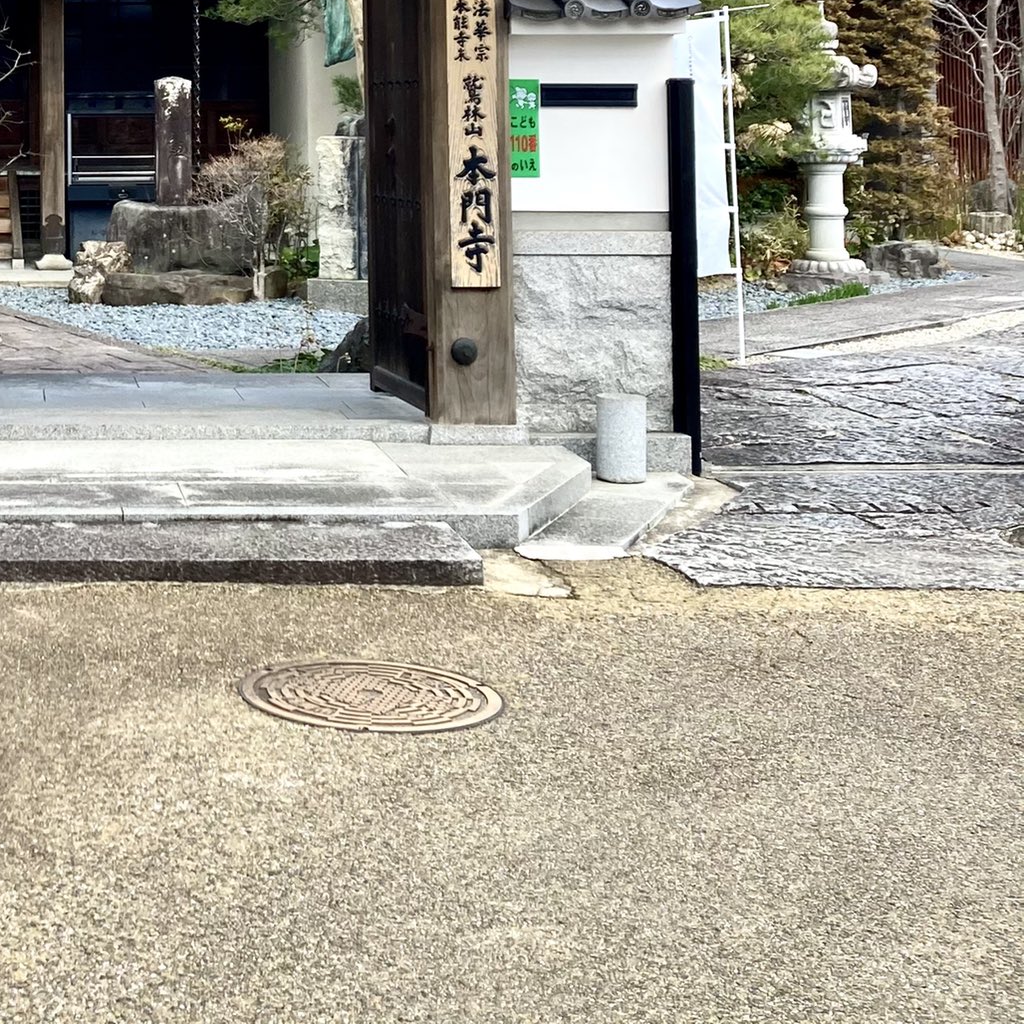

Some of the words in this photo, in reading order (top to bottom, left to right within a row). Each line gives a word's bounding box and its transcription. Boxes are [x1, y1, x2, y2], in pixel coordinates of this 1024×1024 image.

[473, 0, 491, 62] 法華宗
[510, 115, 536, 128] こども
[510, 134, 537, 152] 110番
[511, 158, 536, 171] のいえ
[456, 145, 496, 273] 本門寺
